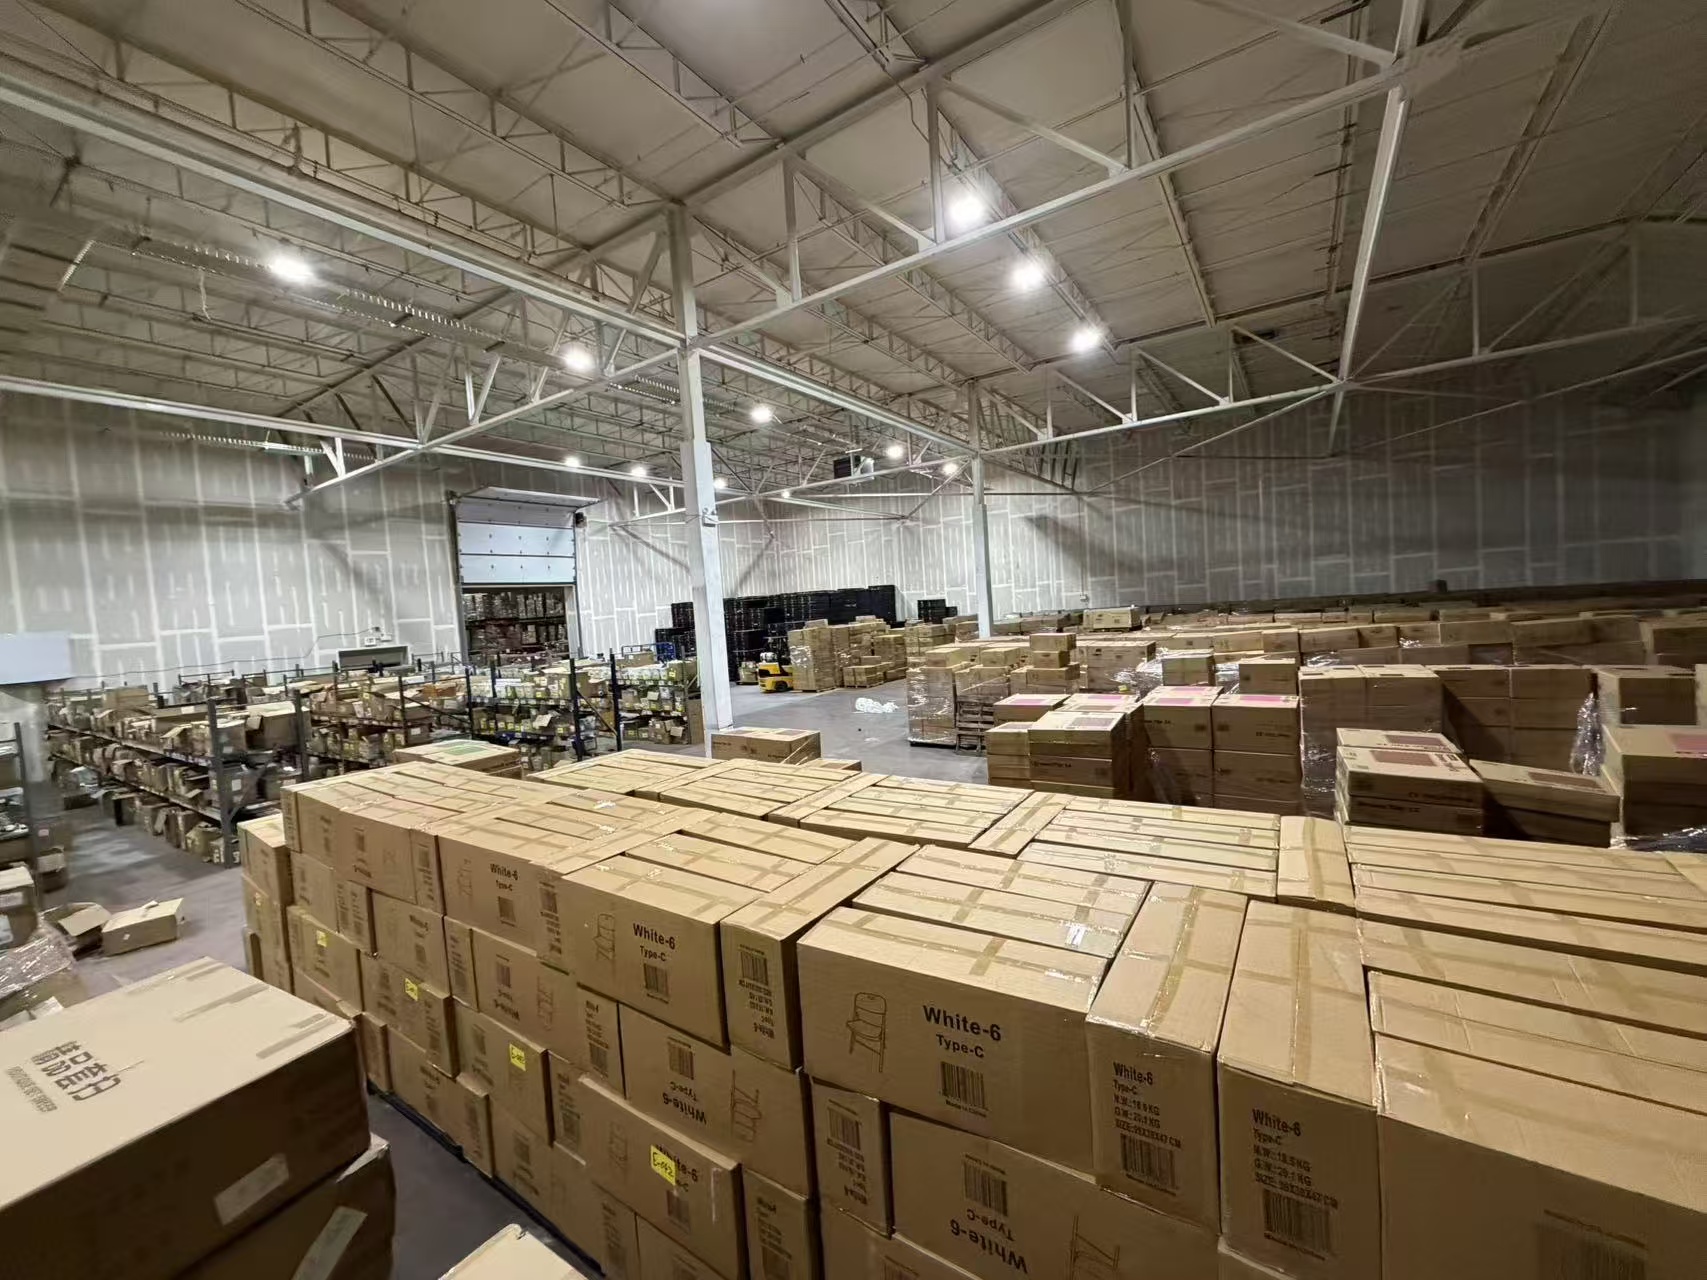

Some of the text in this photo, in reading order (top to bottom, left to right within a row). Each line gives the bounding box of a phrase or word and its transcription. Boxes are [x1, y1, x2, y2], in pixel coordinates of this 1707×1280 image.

[633, 923, 676, 949] White-6
[639, 945, 667, 962] Type-C
[923, 1005, 1001, 1041] White-6
[936, 1034, 984, 1058] Type-C
[1113, 1062, 1153, 1085] White-6
[662, 1092, 707, 1125] White-6
[1252, 1109, 1301, 1137] White-6
[966, 1208, 1015, 1241] Type-C
[950, 1219, 1027, 1274] White-6
